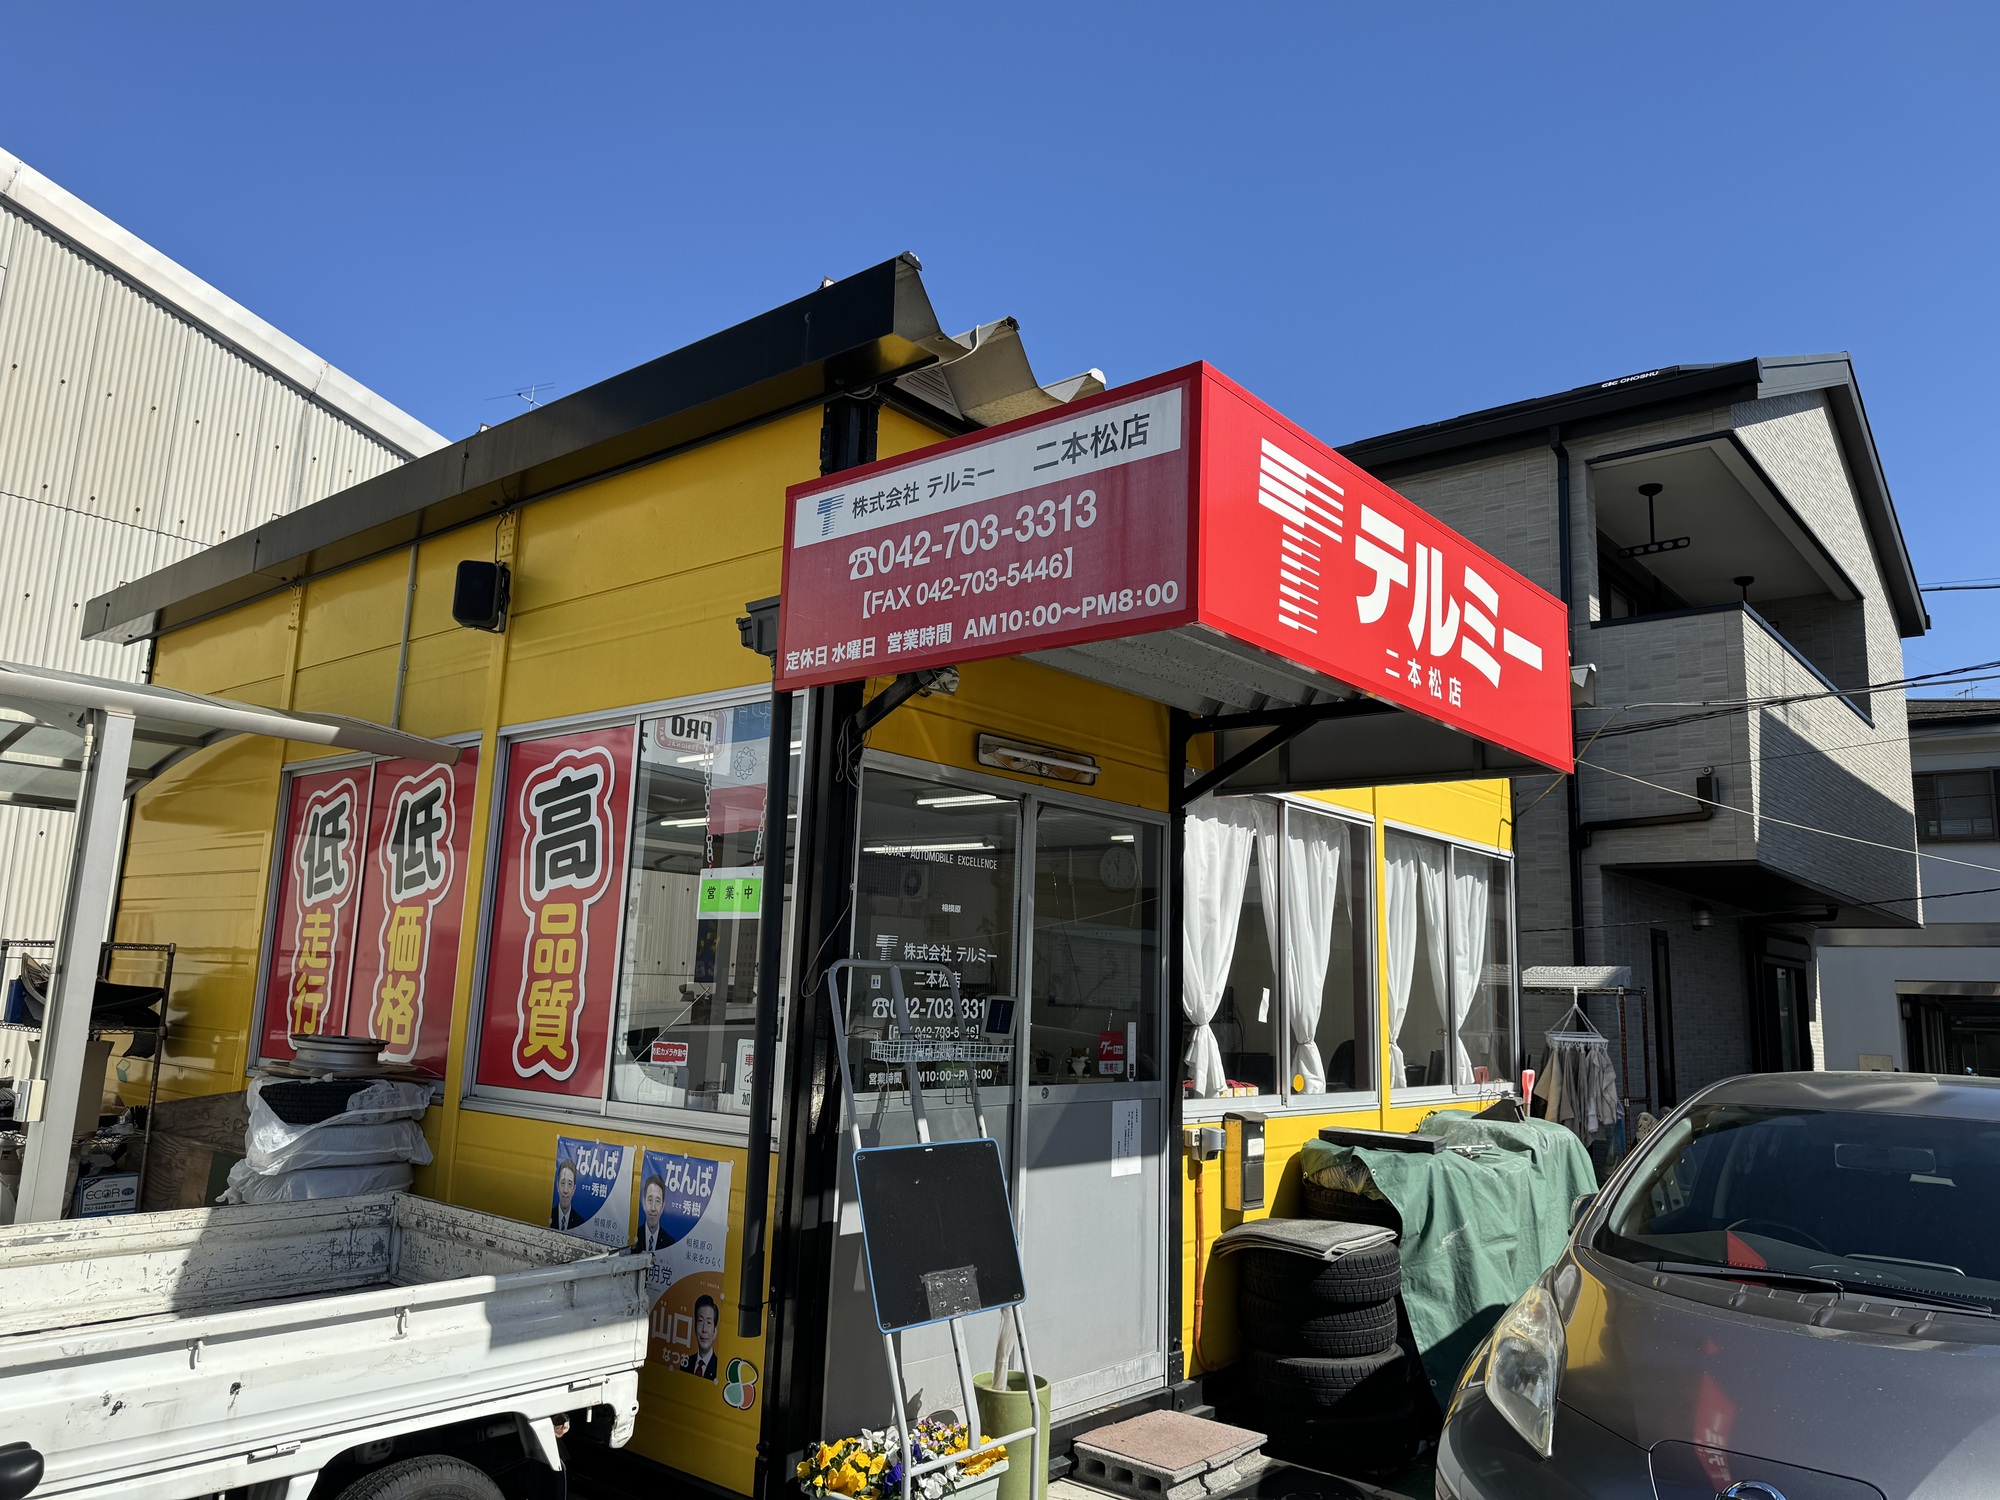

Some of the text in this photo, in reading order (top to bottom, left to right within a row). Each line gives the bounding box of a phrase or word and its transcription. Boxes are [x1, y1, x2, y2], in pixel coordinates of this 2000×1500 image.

[1033, 412, 1151, 472] 二本松店
[852, 466, 995, 519] 株式会社 テルミー
[877, 489, 1097, 574] 042-703-3313
[1355, 503, 1543, 689] テルミー
[785, 644, 828, 671] 定休日
[831, 636, 876, 663] 水曜日
[887, 622, 953, 653] 営業時間
[1385, 648, 1462, 708] 二本松店
[910, 848, 954, 864] AUTOMOBILE
[957, 855, 998, 870] EXCELLENCE
[706, 885, 754, 901] 営業中
[293, 800, 347, 1035] 低走行
[377, 785, 443, 1046] 低価格
[523, 773, 599, 1060] 高品質
[941, 903, 962, 914] 相模原
[904, 942, 998, 963] 株式会社 テルミー
[868, 1072, 903, 1085] 営業時間
[576, 1145, 620, 1180] なんば
[591, 1182, 608, 1199] 秀樹
[664, 1160, 714, 1198] なんば
[682, 1199, 702, 1218] 秀樹
[593, 1217, 618, 1230] 相模原の
[593, 1230, 626, 1244] 未来をひらく
[686, 1237, 713, 1251] 相模原の
[684, 1250, 722, 1268] 未来をひらく
[651, 1306, 693, 1349] 山口
[662, 1347, 689, 1368] なつお
